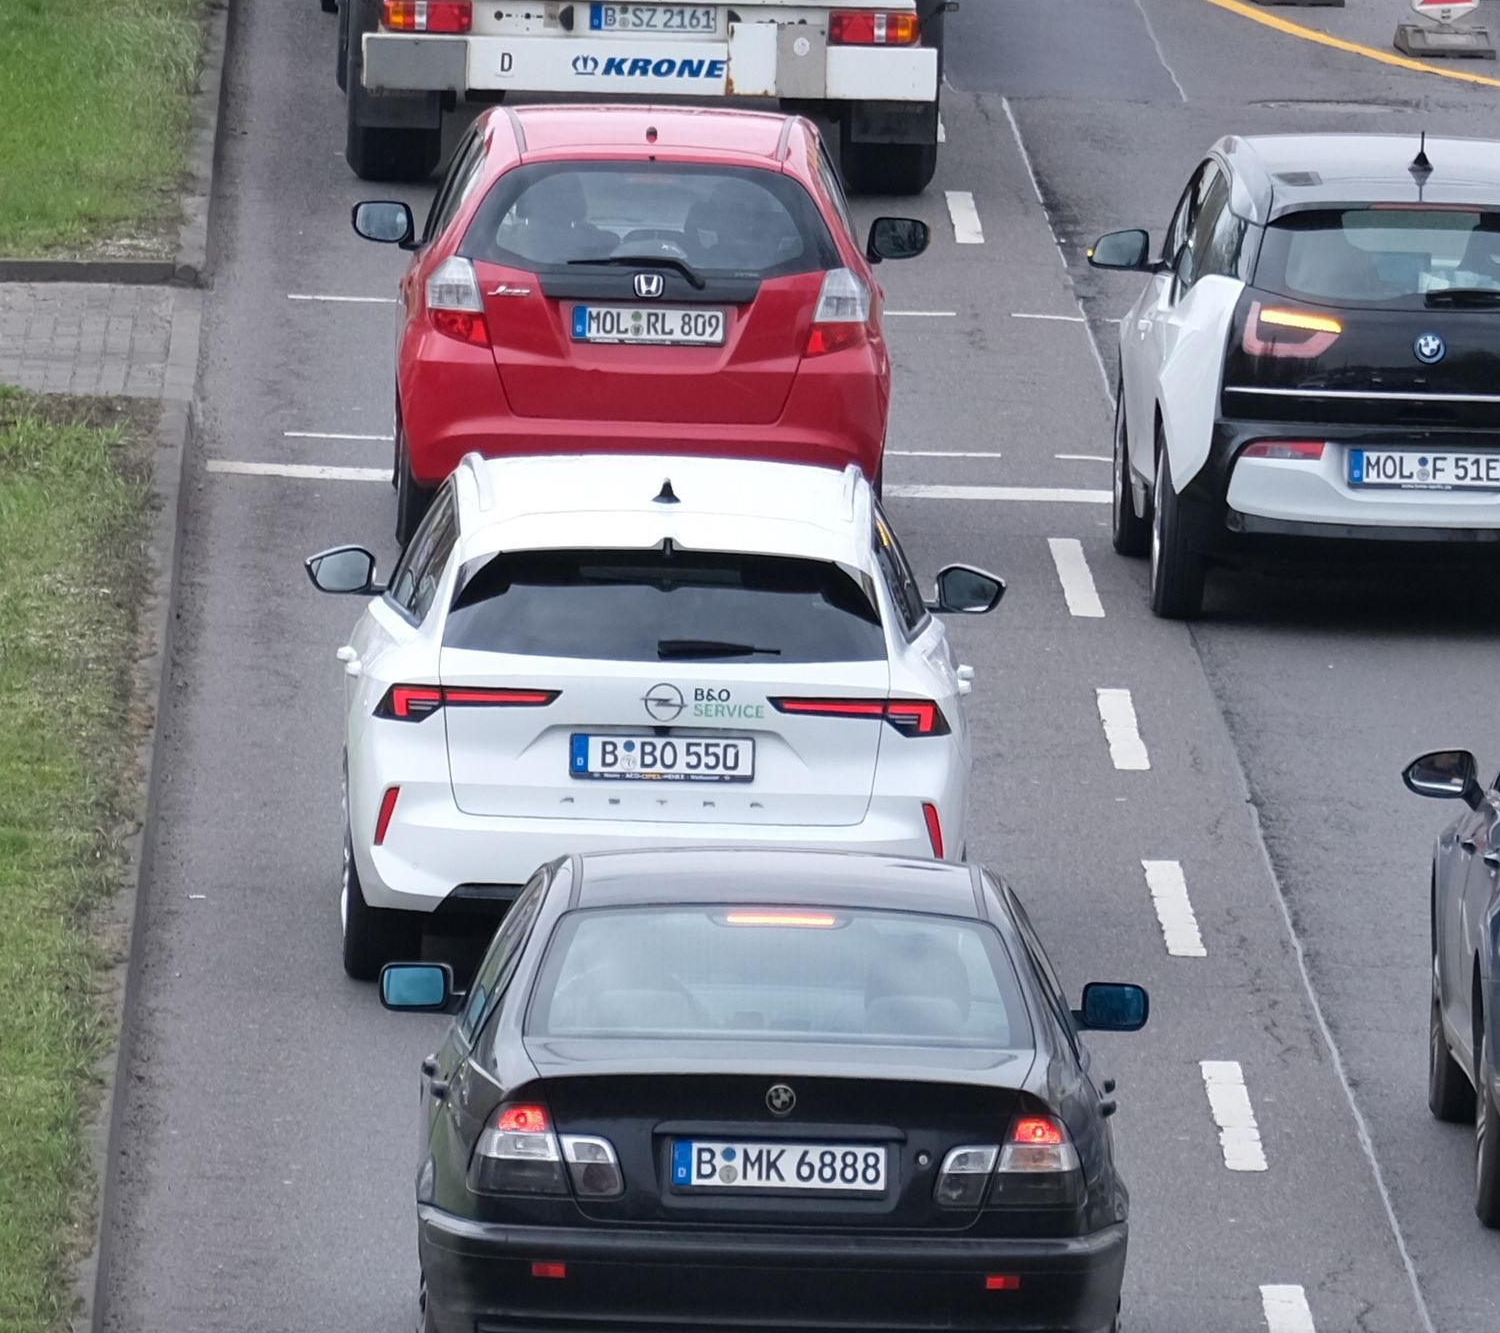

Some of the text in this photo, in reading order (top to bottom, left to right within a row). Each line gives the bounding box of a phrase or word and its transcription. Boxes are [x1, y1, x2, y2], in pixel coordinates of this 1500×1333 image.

[605, 7, 714, 31] B SZ 2161
[500, 52, 727, 80] D KRONE
[588, 310, 721, 338] MOL RL 809
[1364, 454, 1500, 482] MOL F 51E
[694, 687, 731, 703] B&O
[693, 703, 765, 720] SERVICE
[601, 740, 740, 771] B BO 550
[695, 1147, 882, 1184] B MK 6888
